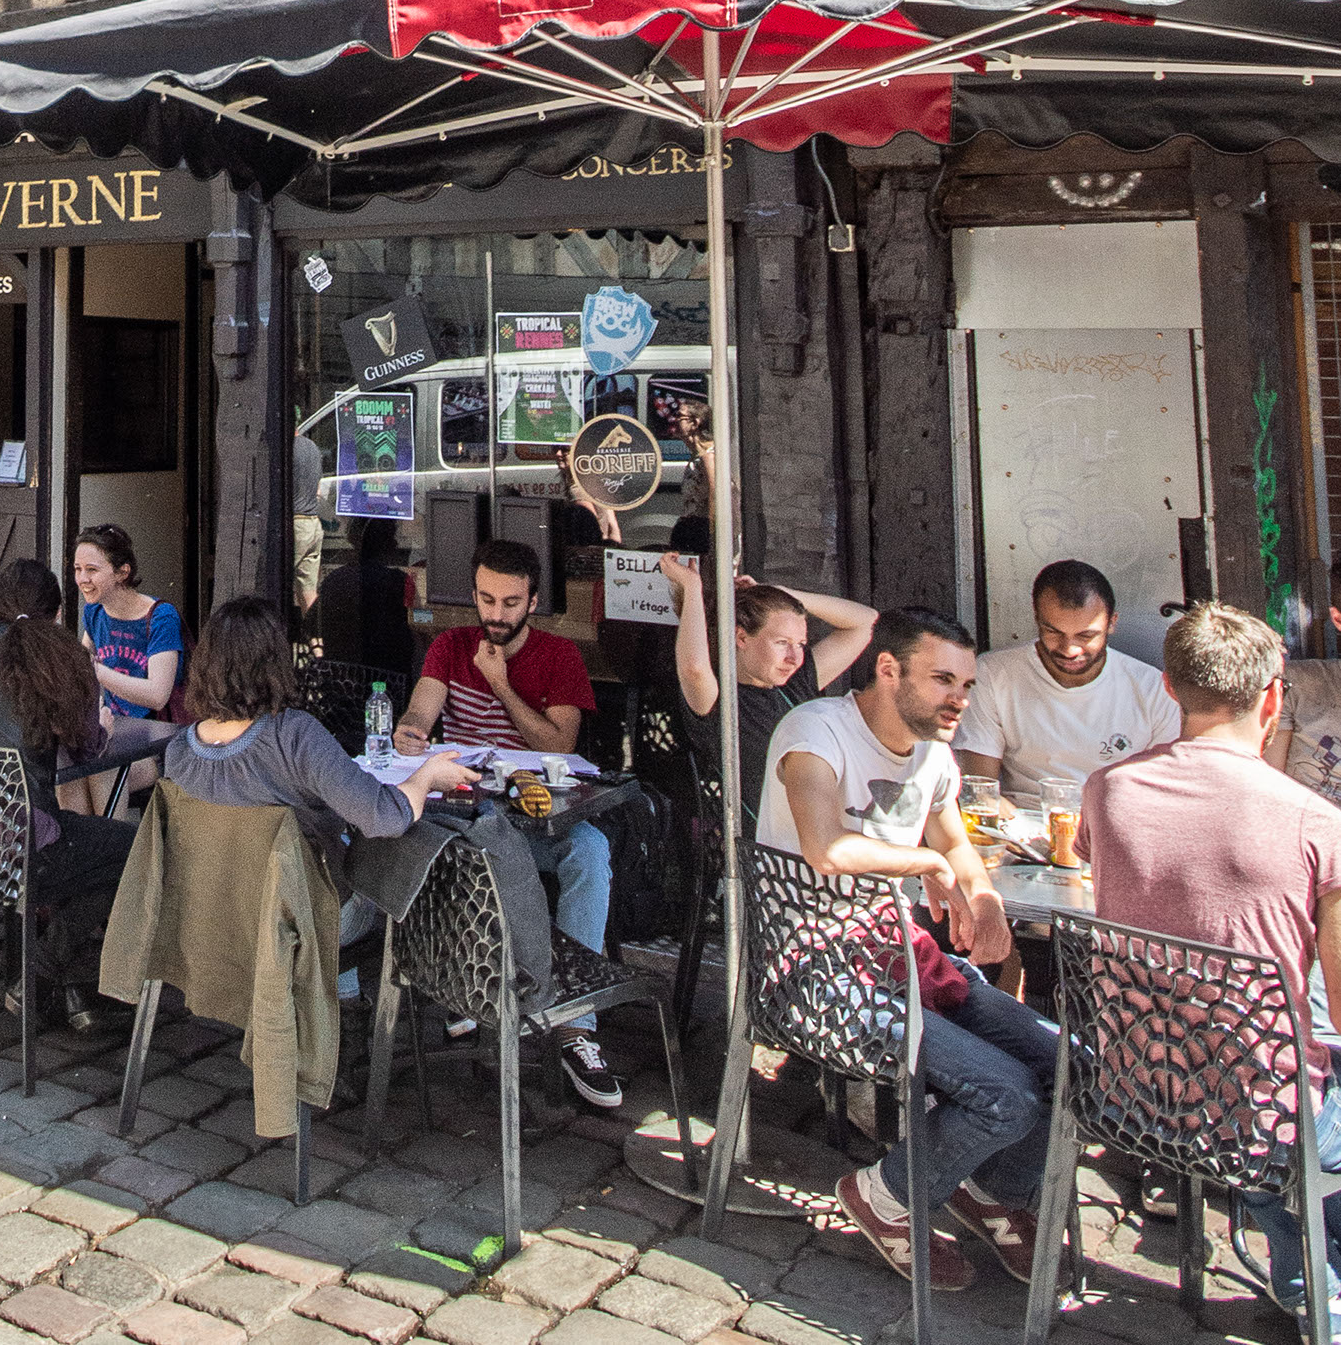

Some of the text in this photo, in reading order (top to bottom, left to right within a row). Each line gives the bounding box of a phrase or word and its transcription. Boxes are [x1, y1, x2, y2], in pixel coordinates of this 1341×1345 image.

[562, 143, 733, 180] ONER
[595, 295, 637, 318] BREW
[515, 317, 562, 331] TROPICAL
[364, 349, 425, 381] GUINNESS
[356, 415, 384, 425] TROPICAL
[575, 453, 655, 475] COREFF
[631, 600, 670, 615] l'étage
